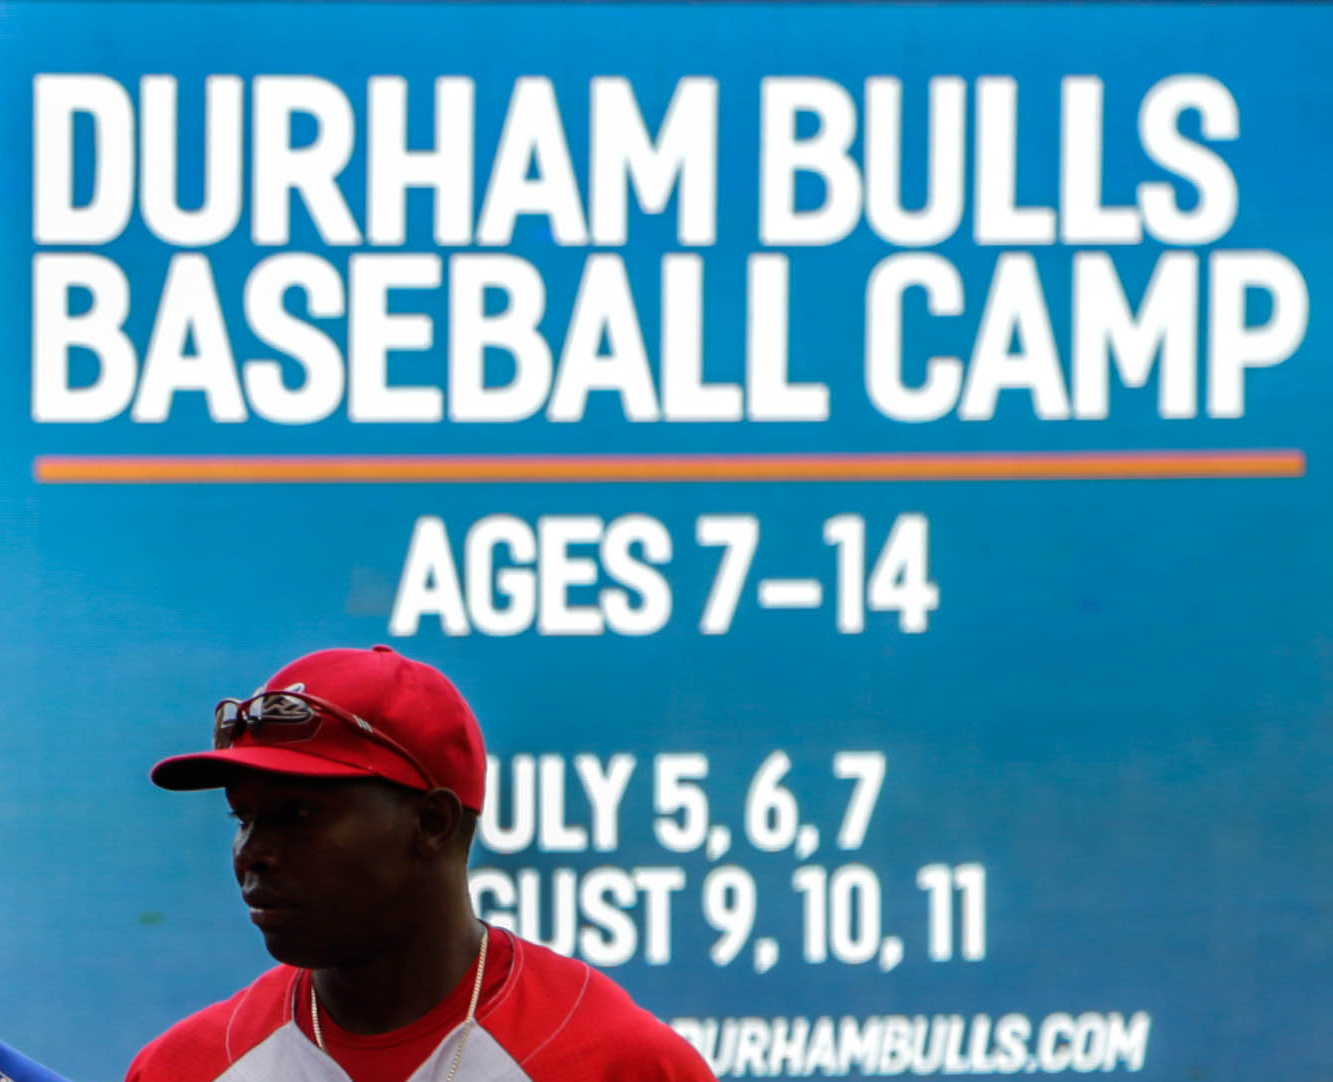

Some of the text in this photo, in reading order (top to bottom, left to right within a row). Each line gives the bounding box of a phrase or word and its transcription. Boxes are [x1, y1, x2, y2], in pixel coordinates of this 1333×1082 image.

[32, 72, 1241, 247] DURHAM BULLS
[31, 249, 1311, 425] BASEBALL CAMP
[388, 514, 674, 638] AGES
[479, 749, 887, 861] ULY 5, 6, 7
[467, 863, 987, 974] GUST 9, 10, 11
